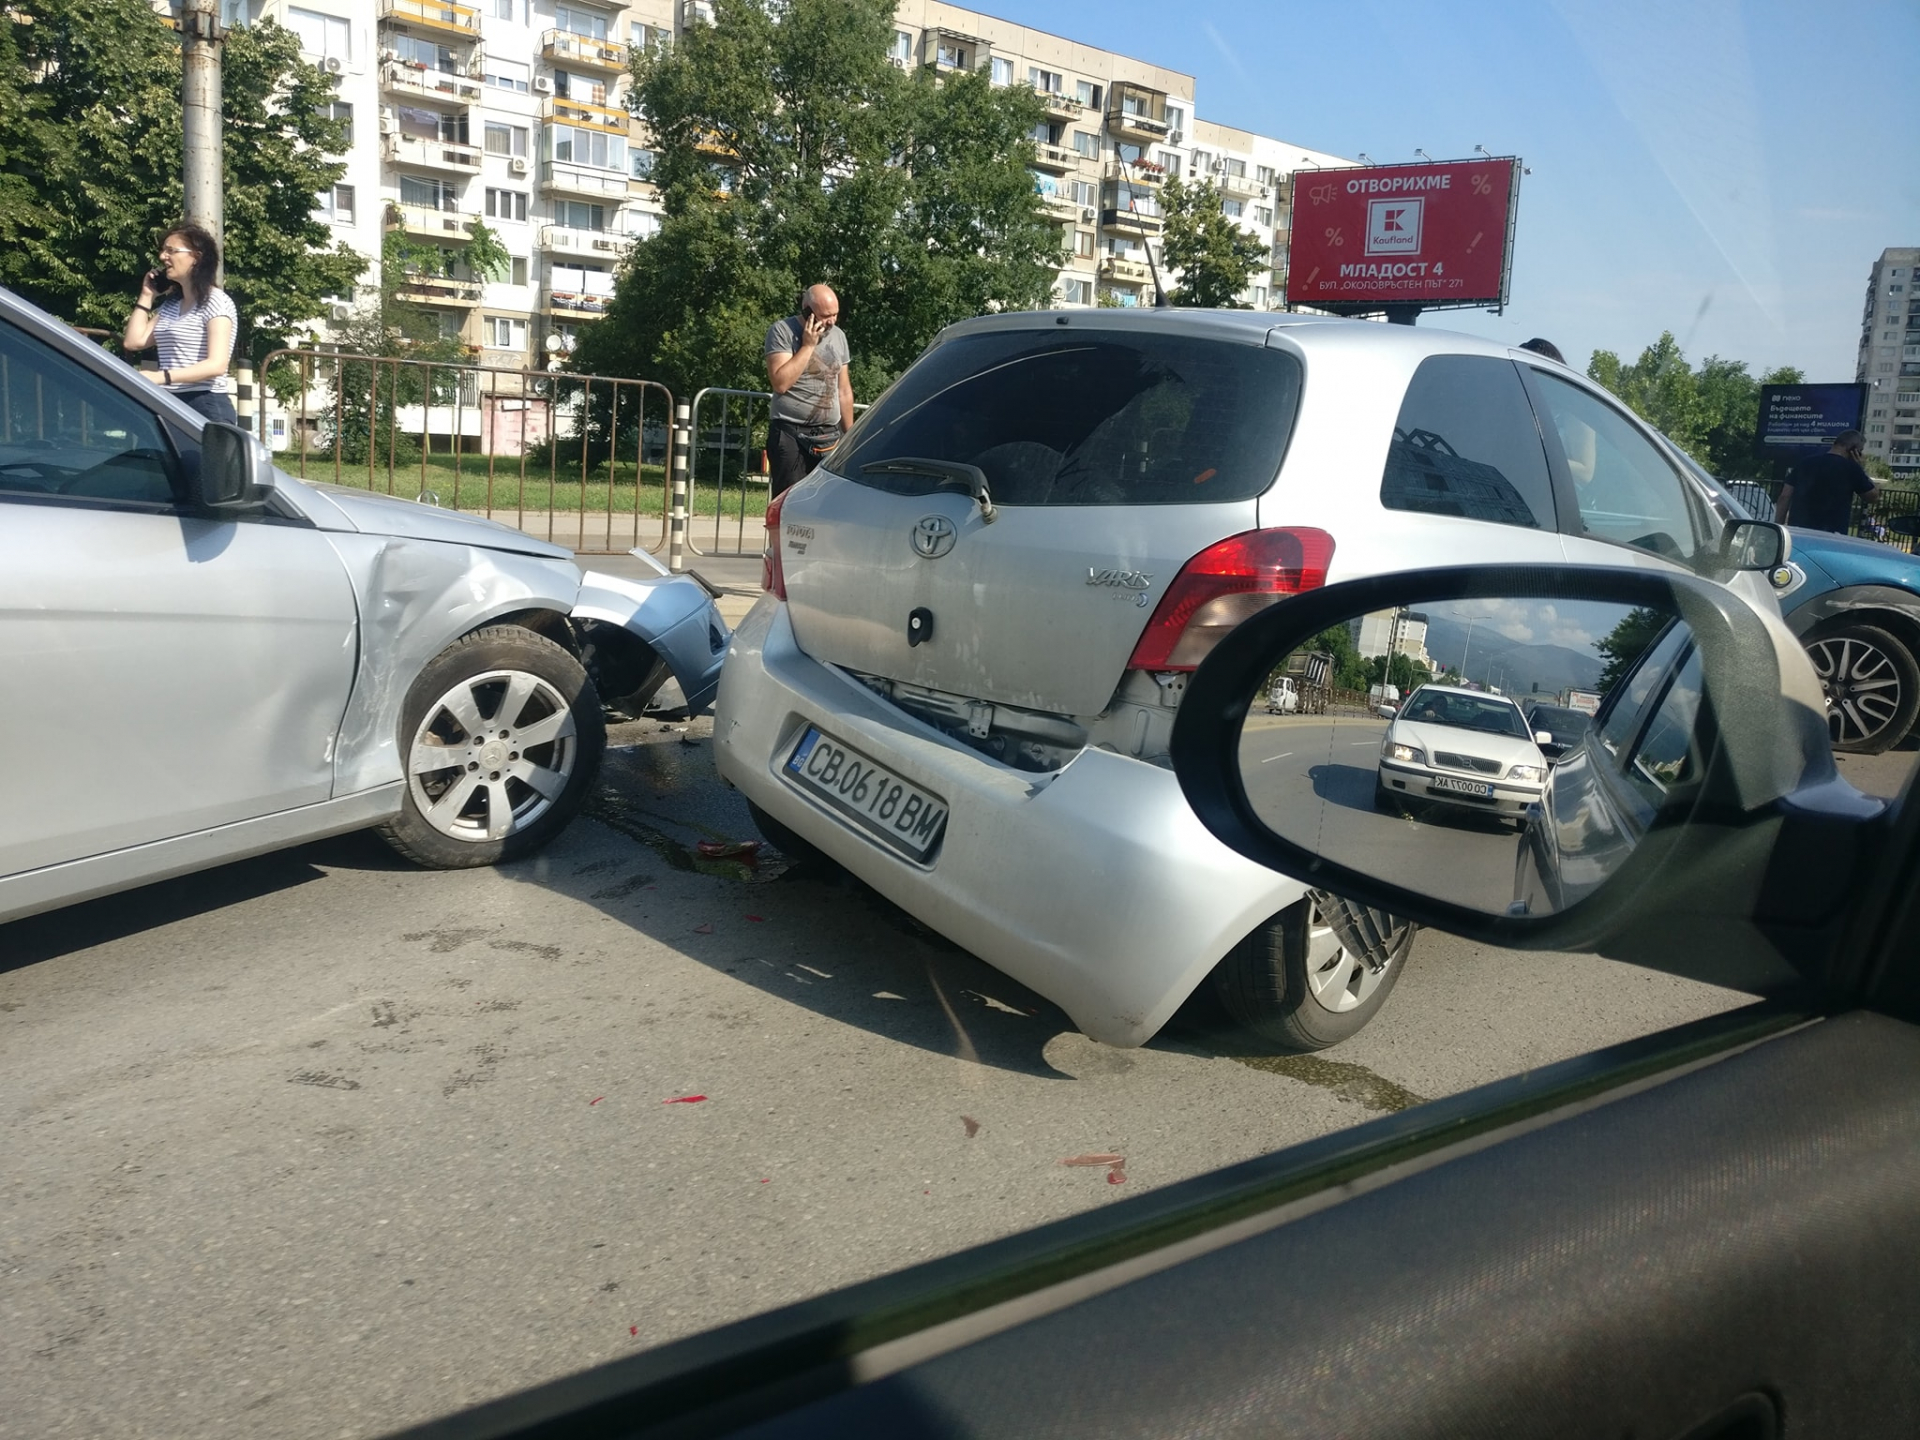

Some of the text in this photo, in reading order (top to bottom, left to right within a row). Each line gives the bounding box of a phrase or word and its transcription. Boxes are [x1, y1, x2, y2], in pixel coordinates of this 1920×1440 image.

[1346, 174, 1451, 194] ОТВОРИХМЕ
[1373, 235, 1413, 245] Kaufland
[1340, 262, 1443, 280] МЛАДОСТ 4
[1448, 278, 1464, 288] 271
[792, 755, 805, 767] BG
